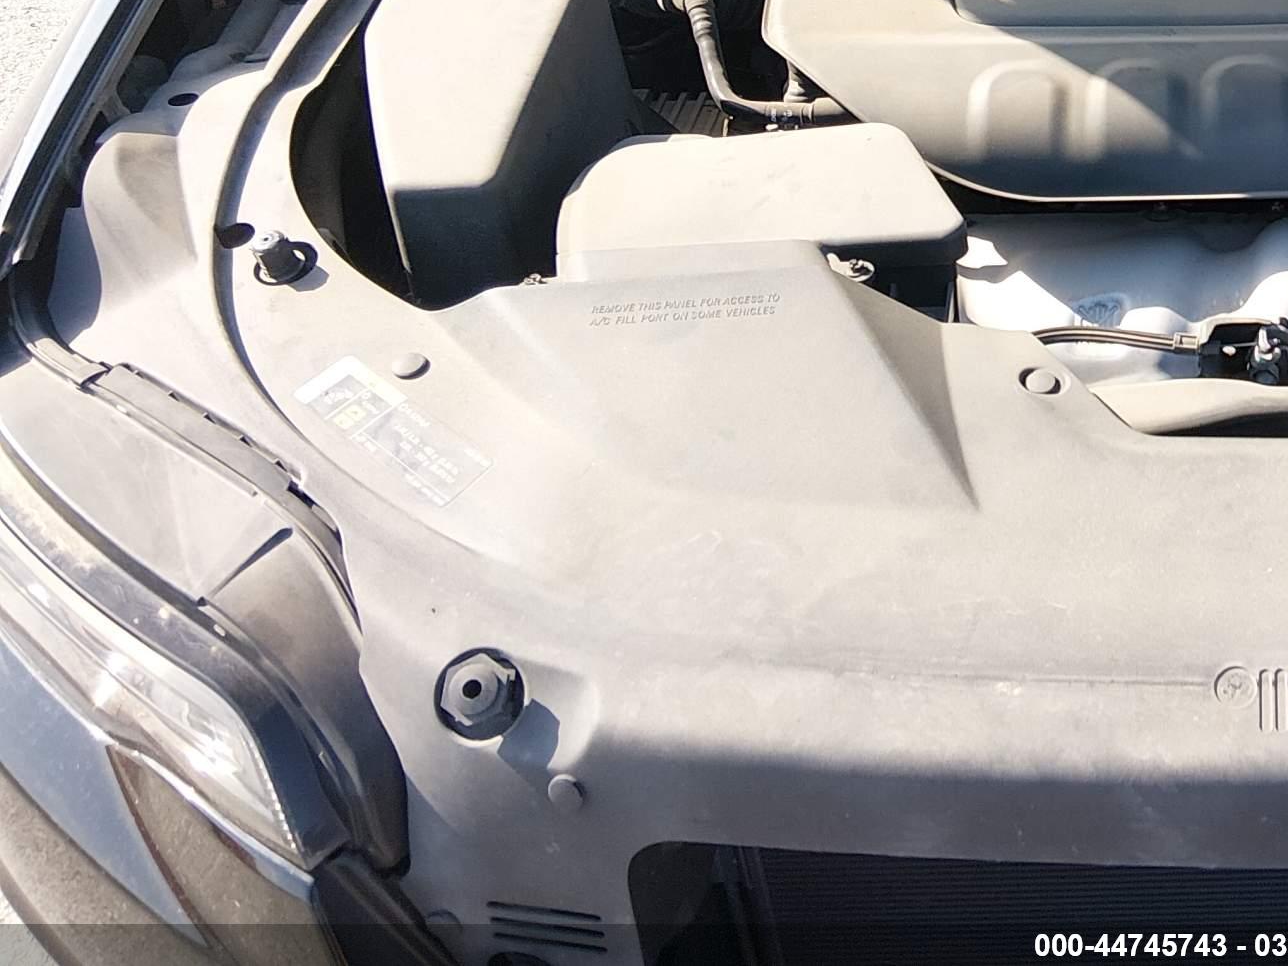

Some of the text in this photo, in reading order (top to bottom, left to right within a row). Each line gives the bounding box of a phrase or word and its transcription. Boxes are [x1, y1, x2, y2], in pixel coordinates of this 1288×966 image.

[591, 292, 781, 314] REMOVE THIS PANEL FOR ACCESS TO
[615, 315, 636, 325] FILL
[640, 313, 669, 322] PORT
[672, 311, 689, 321] ON
[691, 309, 722, 320] SOME
[726, 305, 776, 318] VEHICLES
